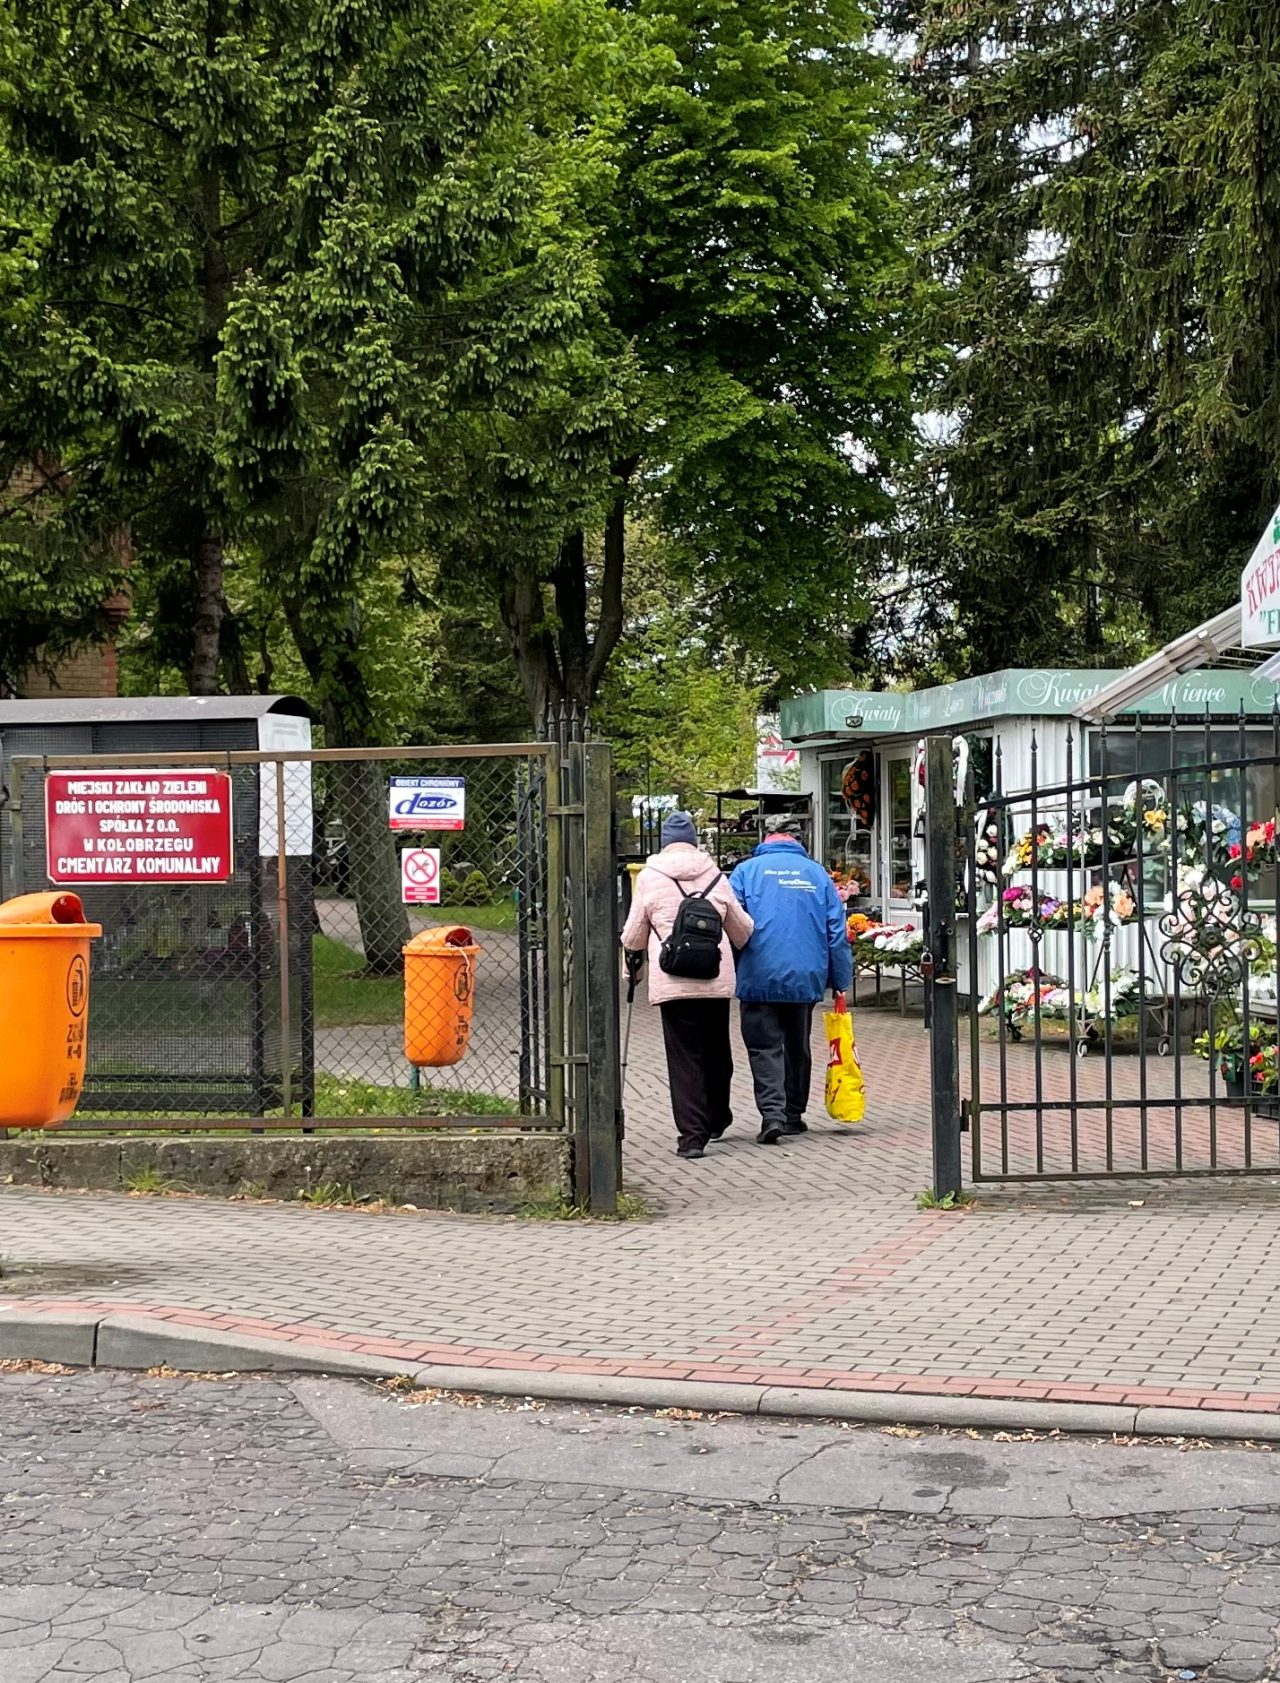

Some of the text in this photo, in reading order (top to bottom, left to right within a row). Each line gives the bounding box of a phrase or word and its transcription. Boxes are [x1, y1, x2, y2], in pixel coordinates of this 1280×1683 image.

[1017, 671, 1101, 707] Kwiat
[1154, 672, 1227, 707] Wieńce
[832, 695, 903, 730] Kwiaty
[67, 780, 207, 795] MIEJSKI ZAKŁAD ZIELENI
[55, 796, 221, 814] DRÓG I OCHRONY ŚRODOWISKA
[395, 792, 457, 815] dozór
[99, 815, 180, 833] SPÓŁKA Z O.O.
[83, 838, 193, 852] W KOŁOBRZEGU
[57, 856, 221, 874] CMENTARZ KOMUNALNY
